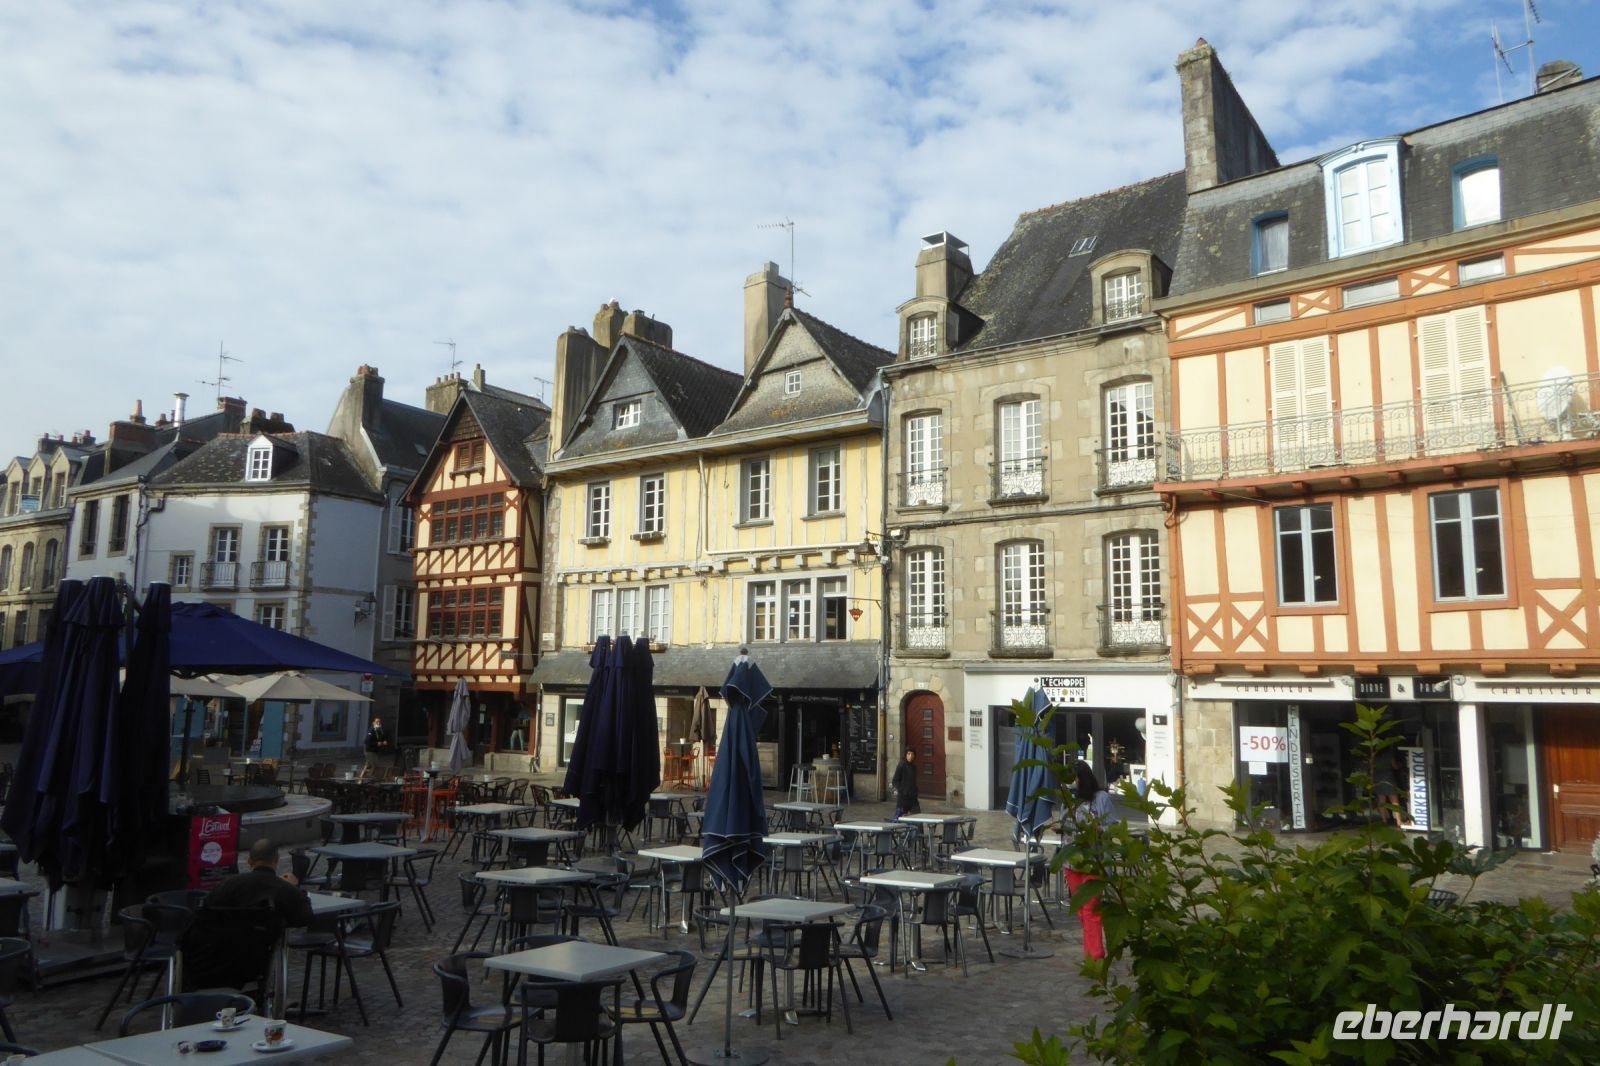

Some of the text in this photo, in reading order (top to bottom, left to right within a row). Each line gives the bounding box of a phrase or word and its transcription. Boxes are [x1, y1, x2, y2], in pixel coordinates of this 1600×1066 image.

[1360, 683, 1384, 693] DIANE
[1397, 683, 1406, 694] &
[1491, 687, 1592, 695] CHAUSSEUR
[1242, 735, 1286, 751] -50%
[1412, 751, 1427, 826] BIRKENSTOCK
